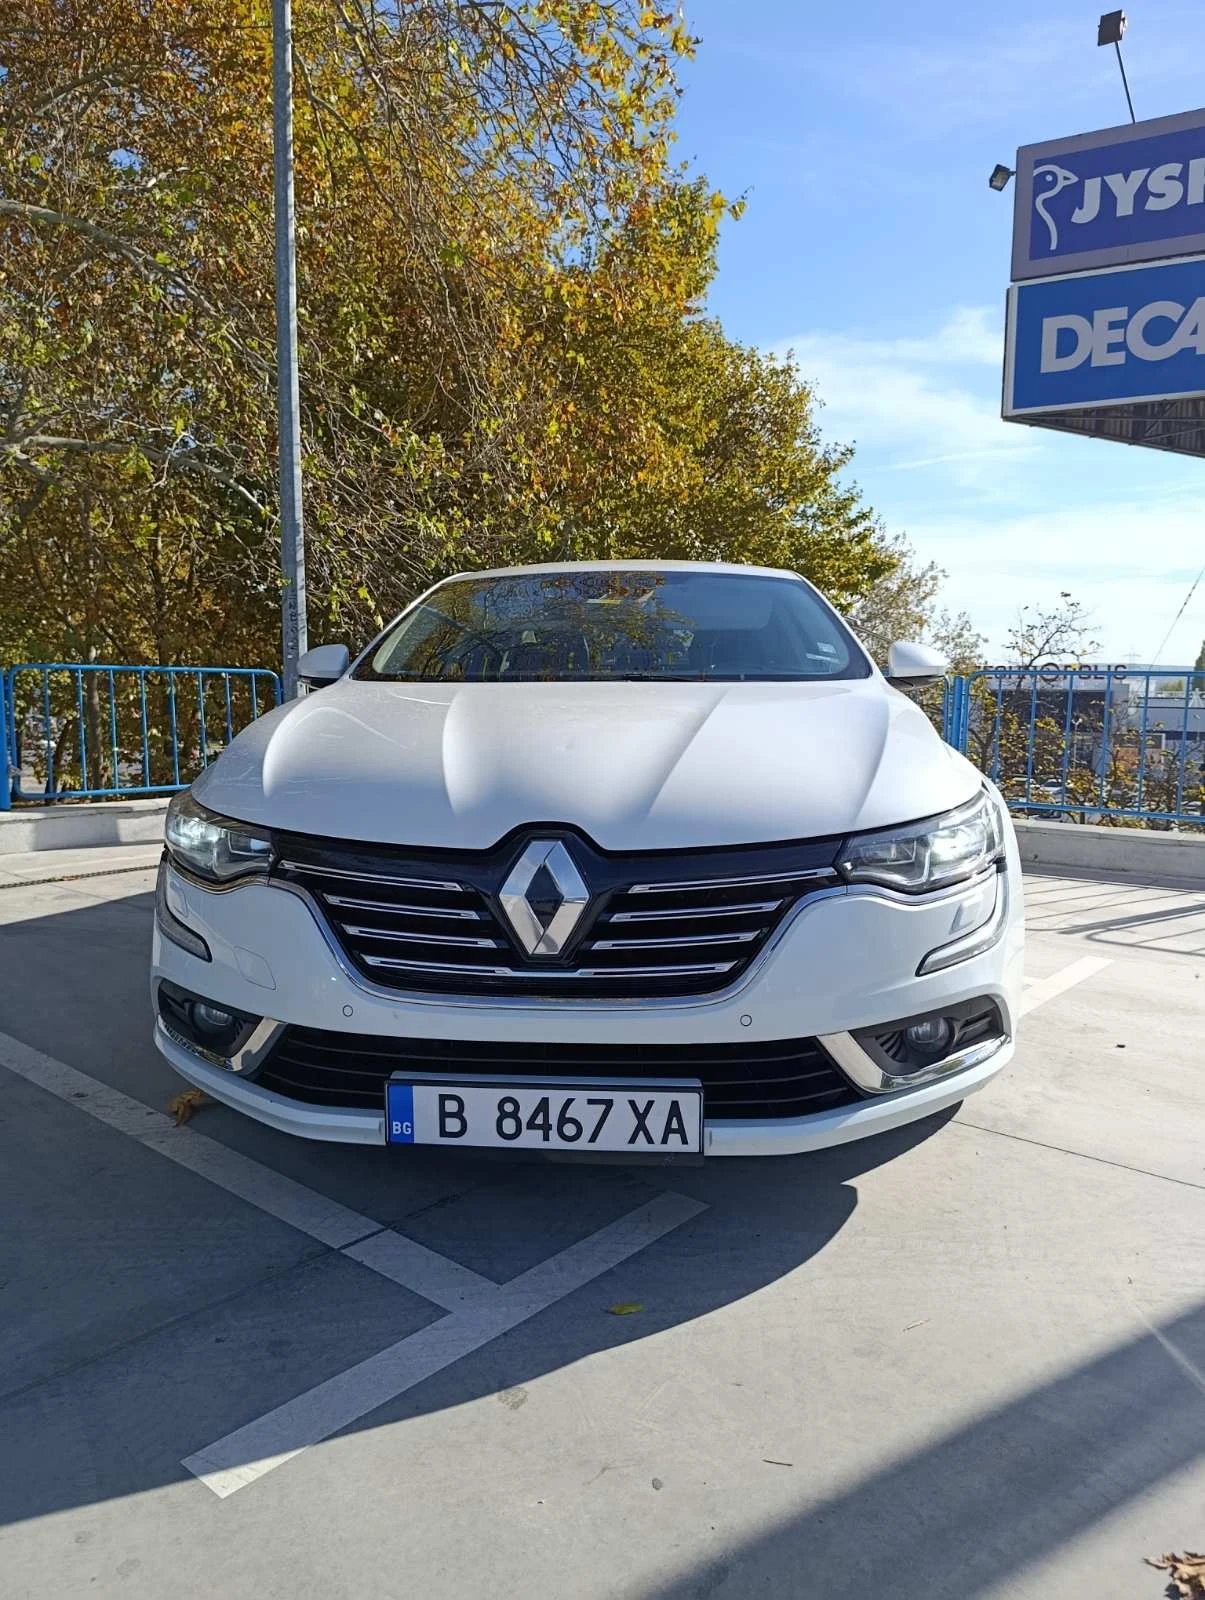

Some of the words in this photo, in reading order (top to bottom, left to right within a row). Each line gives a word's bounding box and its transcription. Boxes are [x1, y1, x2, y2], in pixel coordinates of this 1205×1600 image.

[392, 1121, 412, 1135] BG
[438, 1093, 468, 1138] B
[496, 1096, 614, 1143] 8467
[627, 1099, 689, 1145] XA
